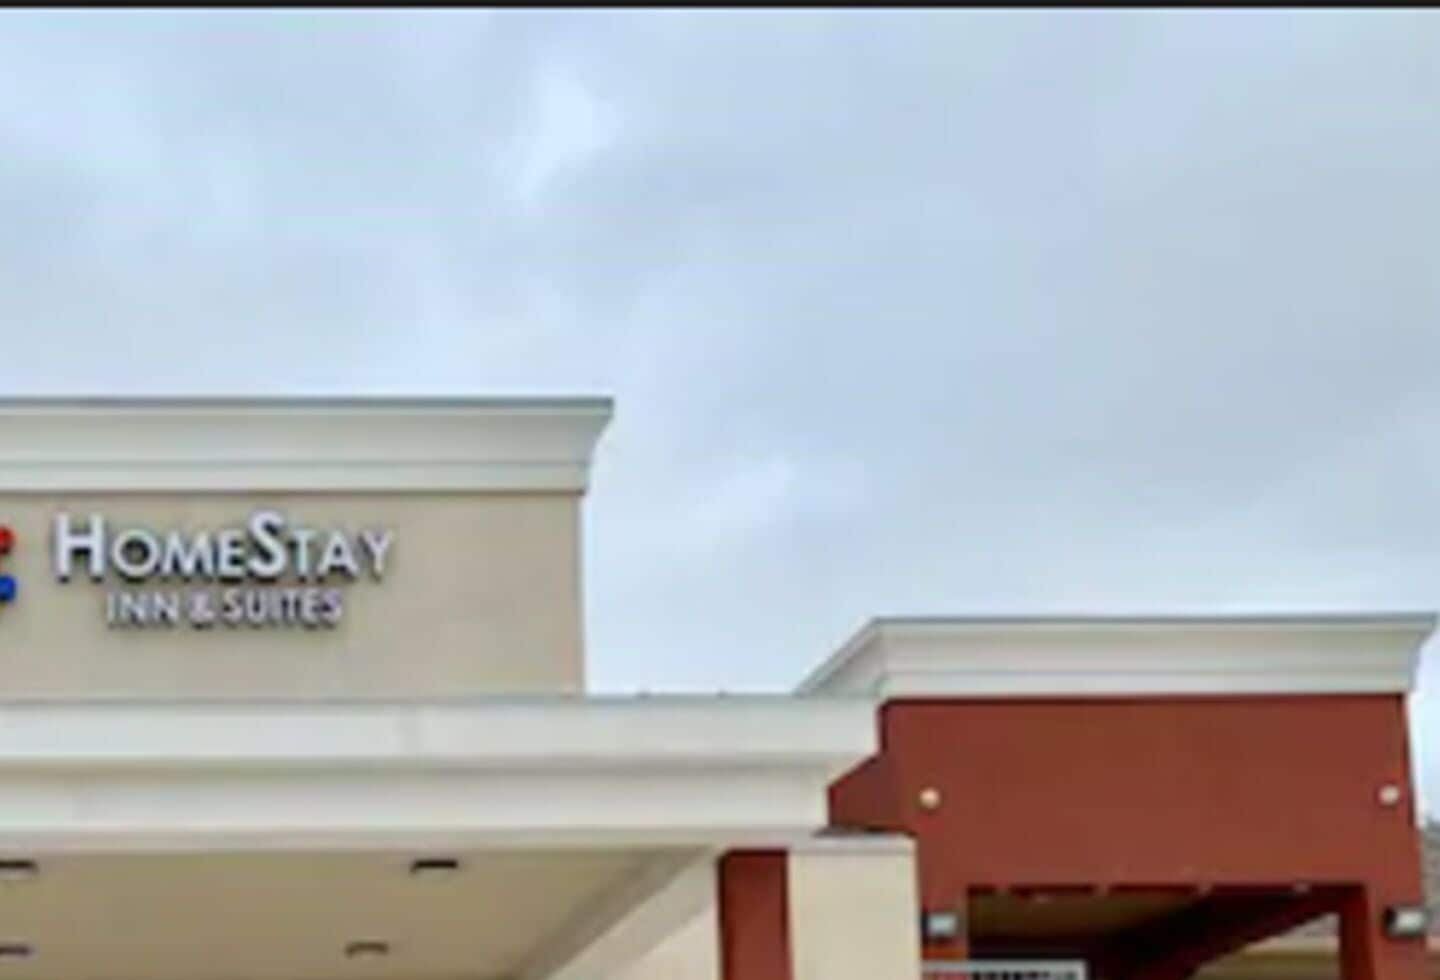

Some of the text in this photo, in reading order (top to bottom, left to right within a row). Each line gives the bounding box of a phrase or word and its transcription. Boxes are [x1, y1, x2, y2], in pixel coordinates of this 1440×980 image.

[56, 510, 394, 579] HOMESTAY
[107, 586, 344, 624] INN & SUITES
